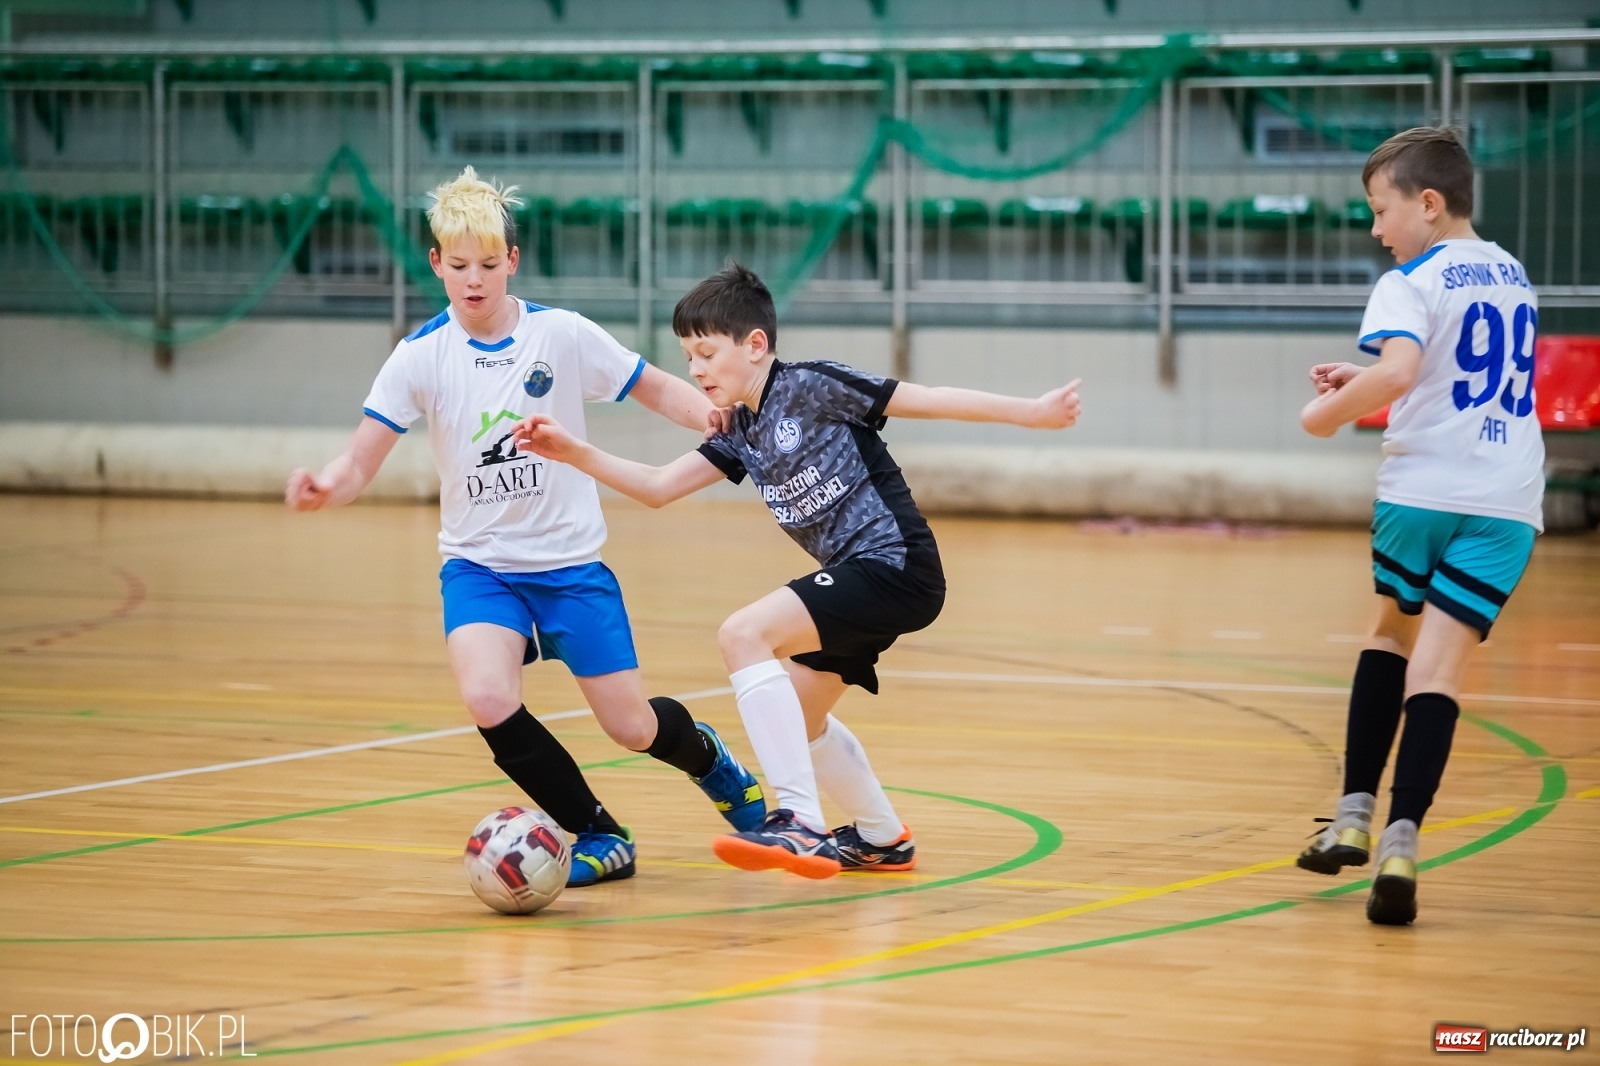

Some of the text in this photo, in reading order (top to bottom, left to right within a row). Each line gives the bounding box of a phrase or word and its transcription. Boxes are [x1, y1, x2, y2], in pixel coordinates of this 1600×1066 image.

[1452, 301, 1537, 417] 99
[776, 421, 797, 444] LKS
[466, 462, 543, 498] D-ART
[797, 475, 849, 517] GRUCHEL
